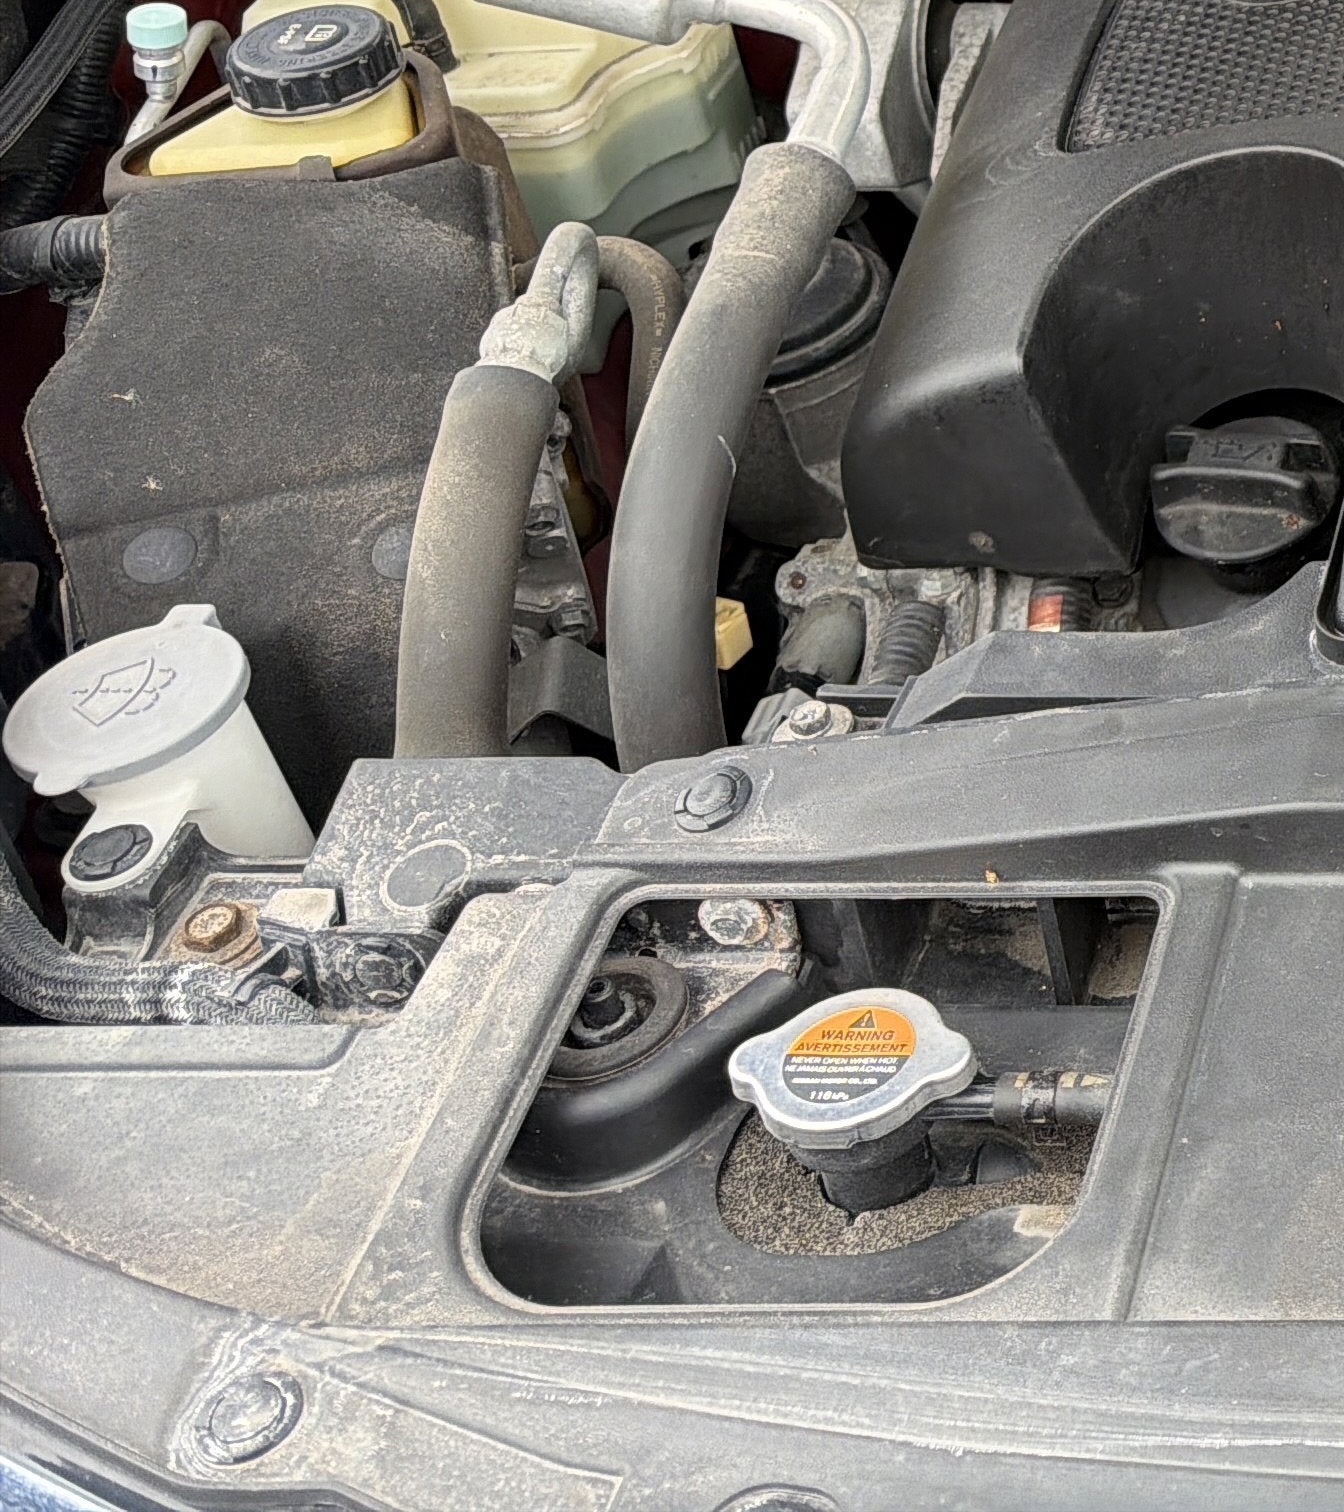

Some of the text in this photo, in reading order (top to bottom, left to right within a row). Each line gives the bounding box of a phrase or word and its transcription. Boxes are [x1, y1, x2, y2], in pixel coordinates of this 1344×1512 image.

[821, 1029, 896, 1041] WARNING
[795, 1043, 908, 1053] AVERTISSEMENT
[791, 1056, 821, 1065] NEVER
[822, 1056, 847, 1065] OPEN
[849, 1056, 877, 1065] WHEN
